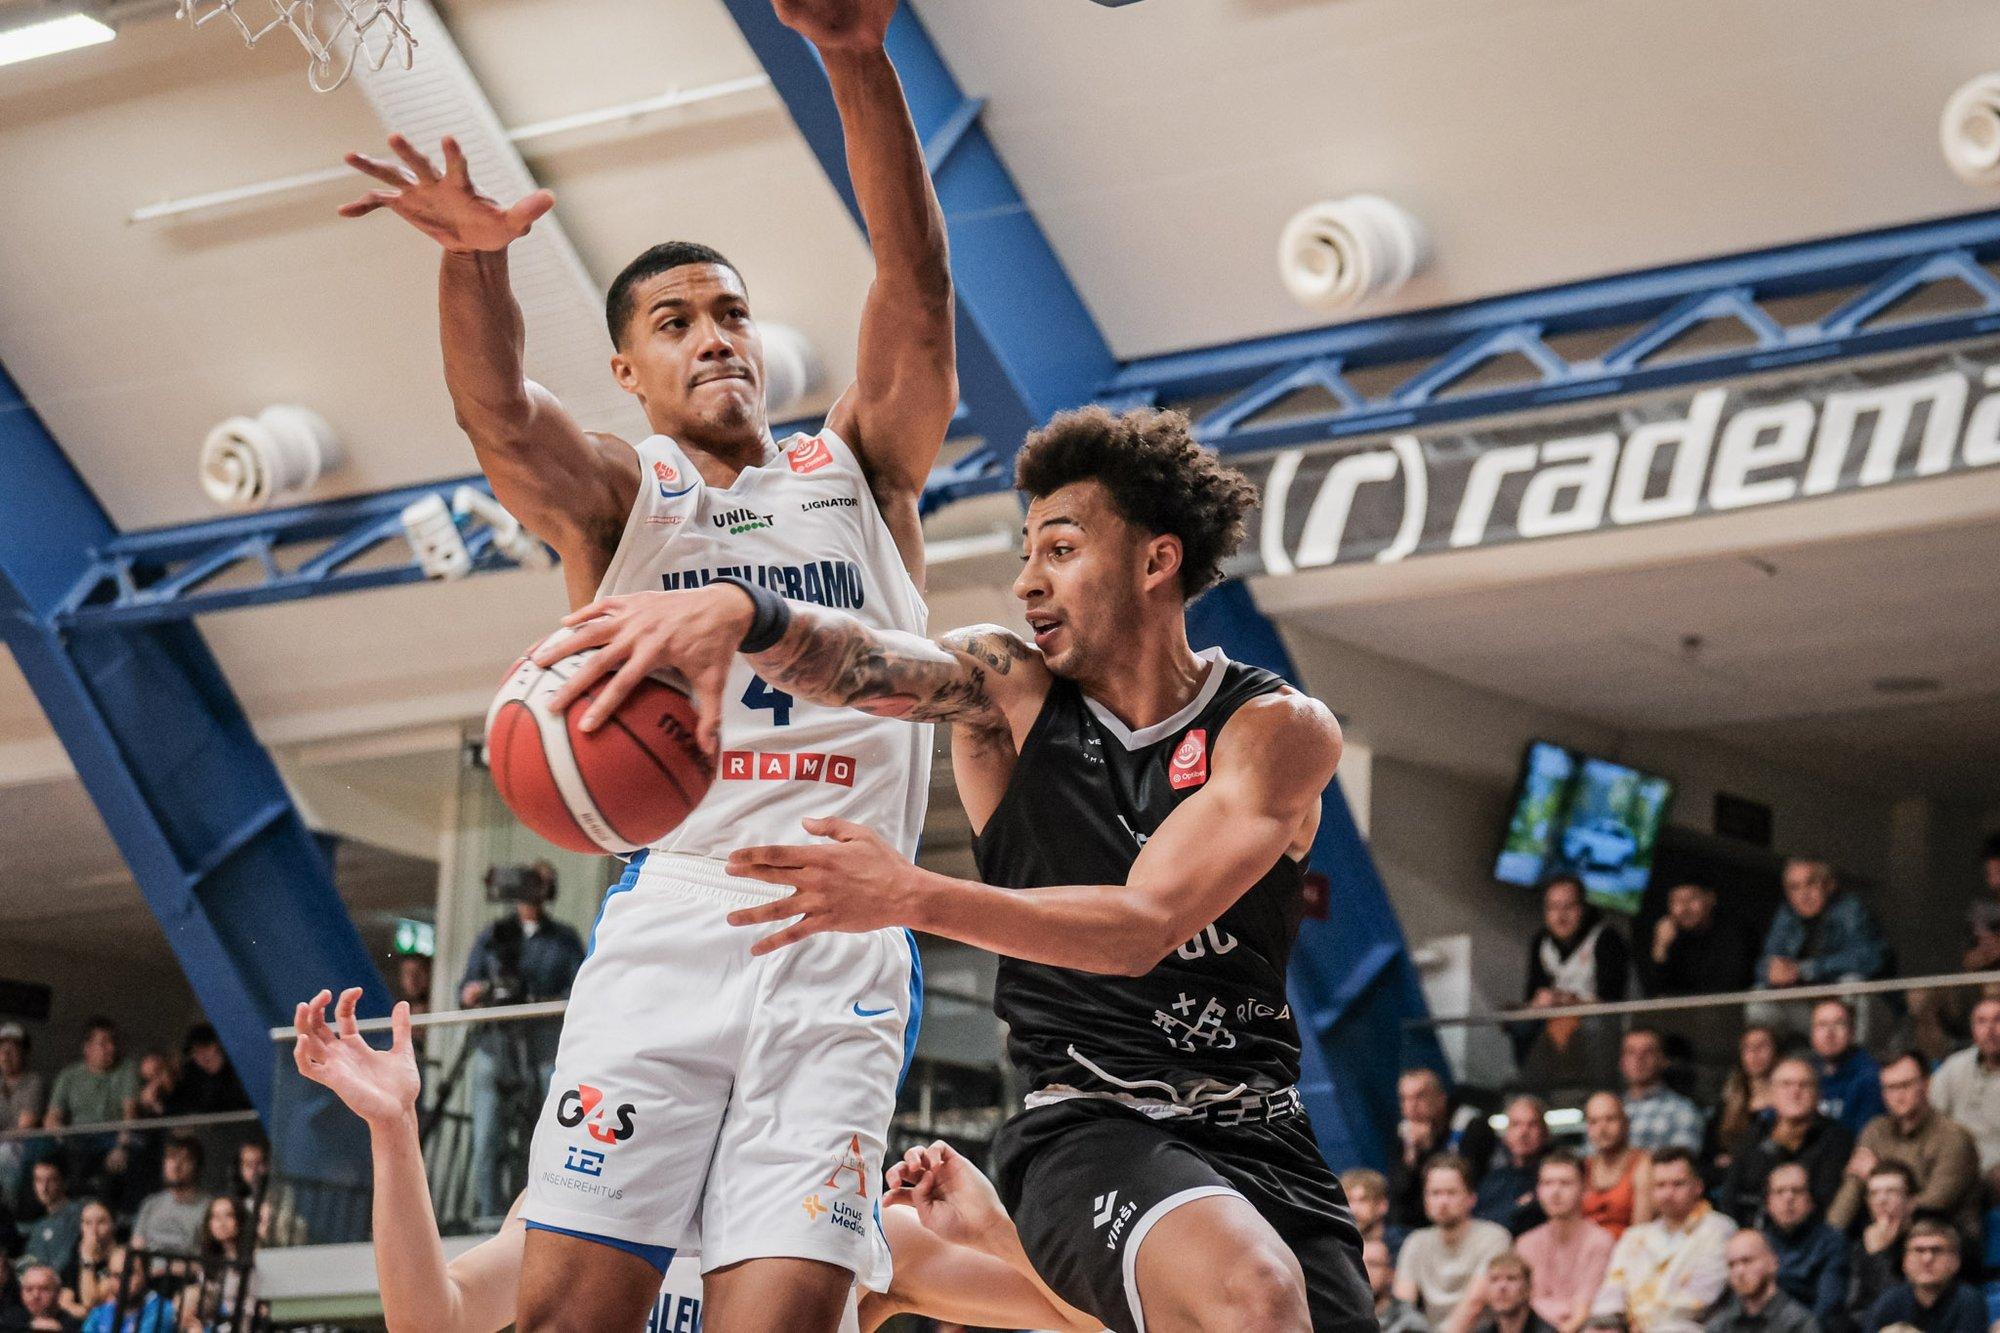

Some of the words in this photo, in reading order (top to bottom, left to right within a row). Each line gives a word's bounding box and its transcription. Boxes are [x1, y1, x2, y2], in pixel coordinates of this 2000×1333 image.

[801, 497, 859, 512] LIGNATOR
[712, 508, 774, 528] UNIBT
[741, 674, 793, 726] 4
[729, 756, 850, 780] RAMO
[1236, 997, 1291, 1023] RĪGA
[556, 1083, 637, 1146] G4S
[542, 1171, 624, 1200] INSENEREHITUS
[833, 1201, 863, 1221] Linus
[1106, 1201, 1138, 1250] VIRŠI
